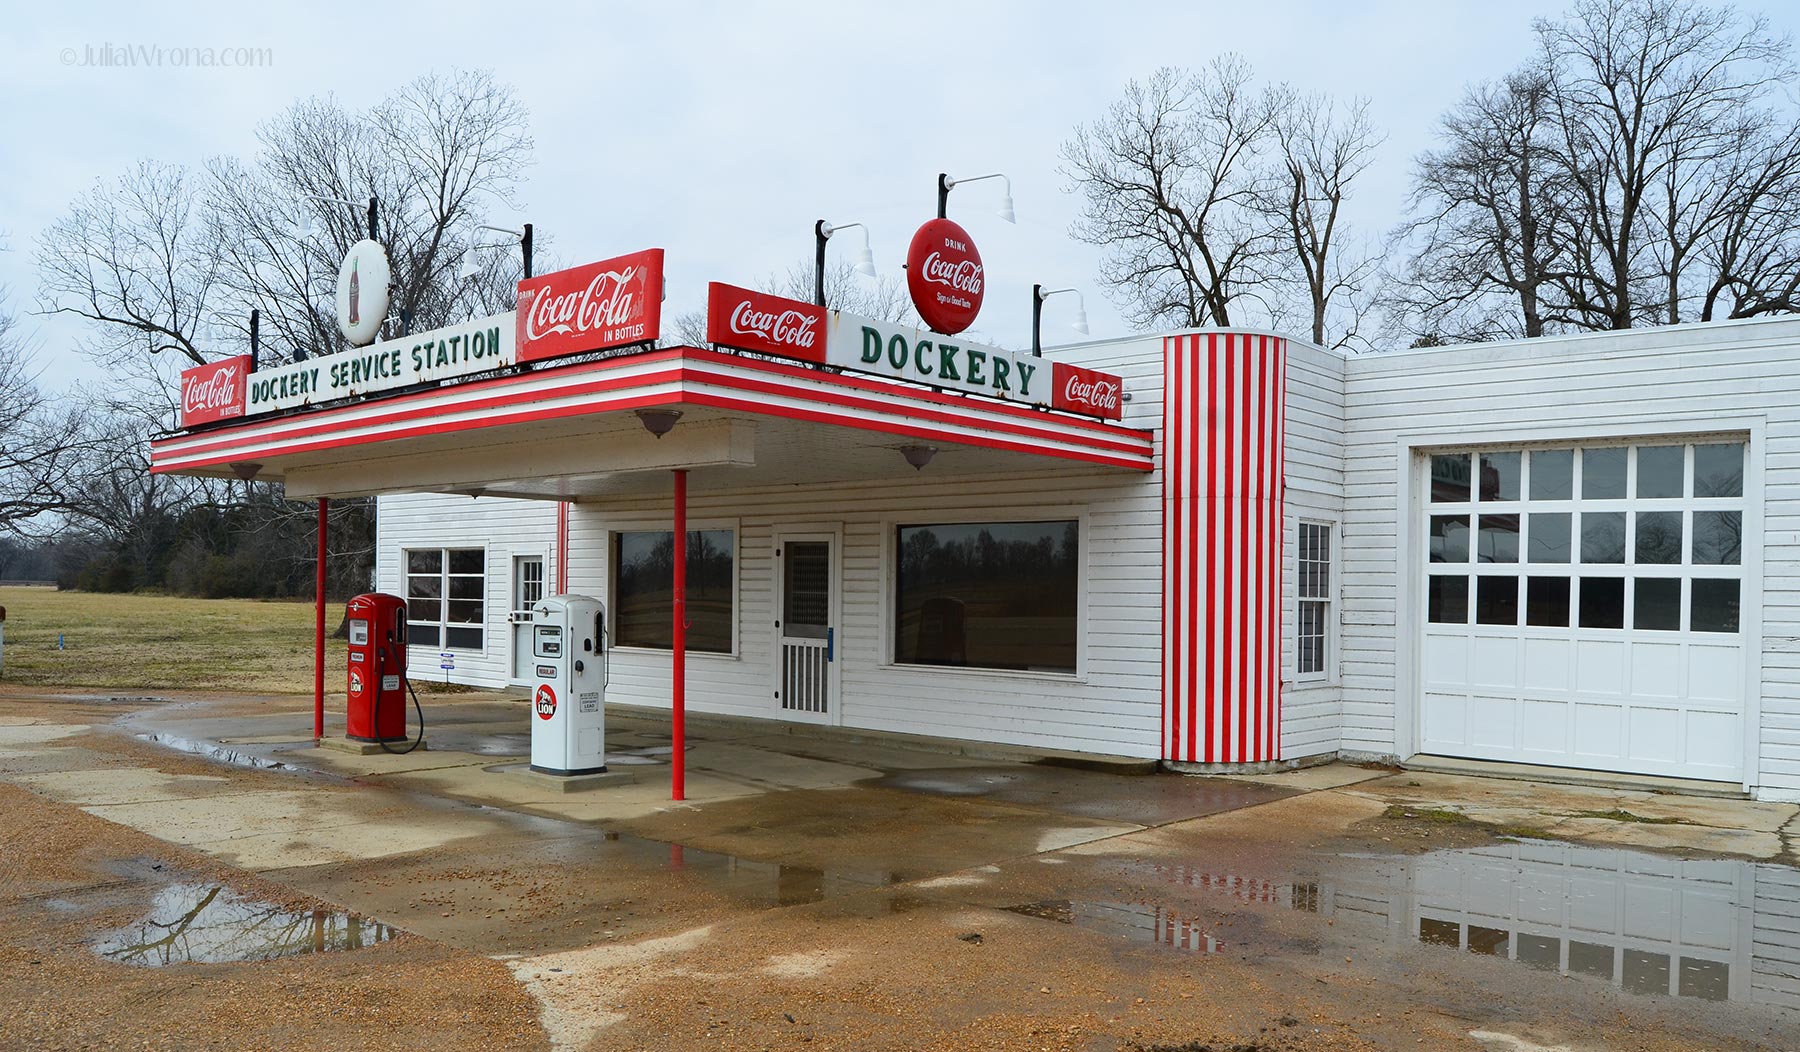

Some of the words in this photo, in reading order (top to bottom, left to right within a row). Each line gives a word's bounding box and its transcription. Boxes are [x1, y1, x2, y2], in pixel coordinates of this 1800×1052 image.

[945, 238, 966, 252] DRINK
[922, 251, 982, 295] Coca-Cola
[519, 289, 535, 299] DRINK
[526, 264, 639, 340] Coca-Cola
[936, 291, 946, 304] Sign
[604, 330, 612, 342] IN
[615, 323, 644, 340] BOTTLES
[730, 300, 819, 348] Coca-Cola
[251, 368, 319, 404] DOCKERY
[330, 349, 401, 388] SERVICE
[411, 326, 500, 372] STATION
[861, 325, 1036, 395] DOCKERY
[185, 365, 237, 413] Coca-Cola
[1065, 374, 1118, 410] Coca-Cola
[537, 702, 554, 715] LION
